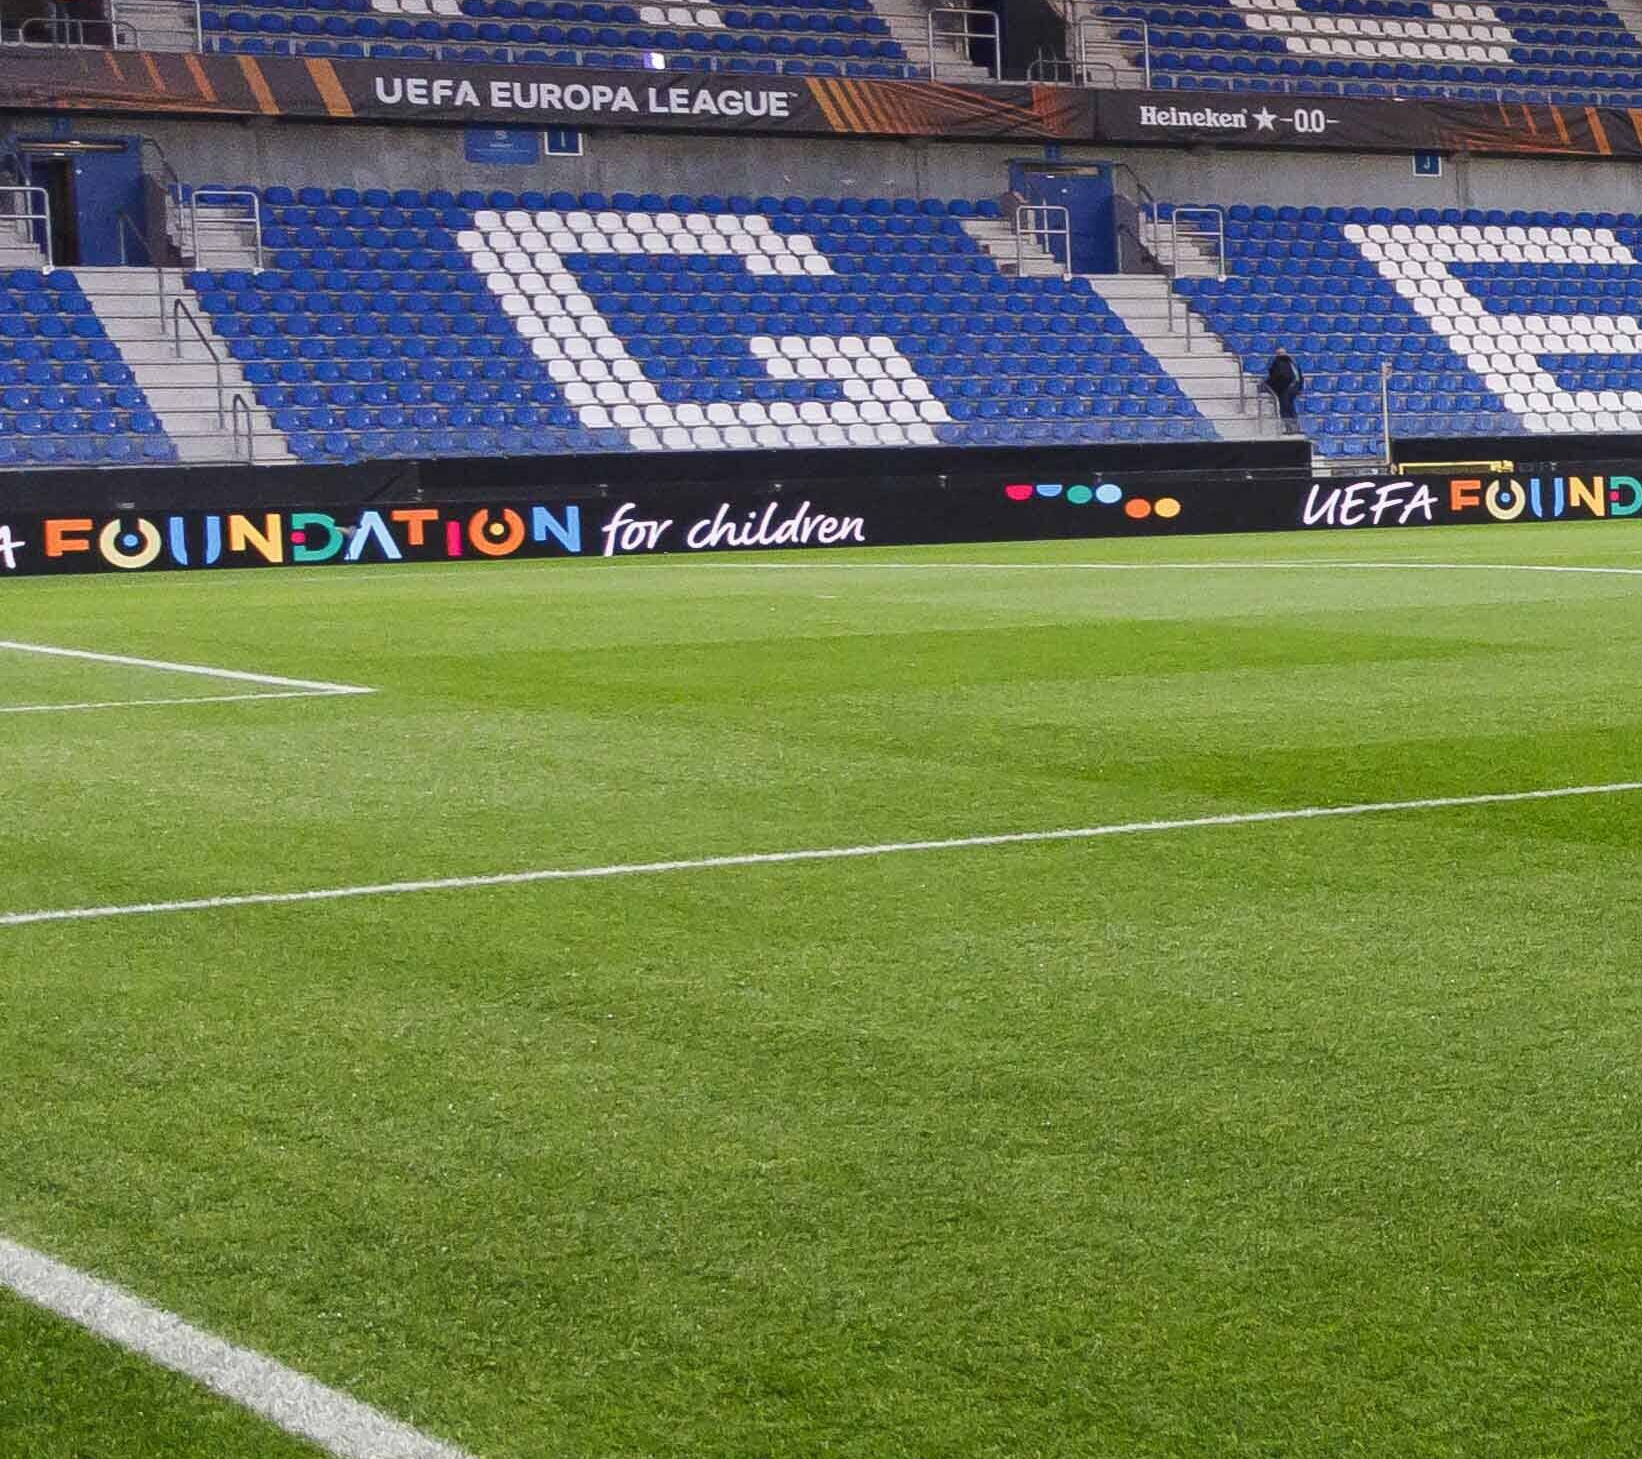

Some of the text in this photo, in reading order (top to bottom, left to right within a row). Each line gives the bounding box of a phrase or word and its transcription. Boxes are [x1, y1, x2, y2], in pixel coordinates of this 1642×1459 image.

[375, 77, 791, 118] UEFA EUROPA LEAGUE
[1140, 105, 1248, 129] Heineken
[1303, 482, 1438, 525] UEFA
[44, 506, 581, 569] FOUNDATION
[602, 502, 673, 557] for
[687, 501, 866, 550] children
